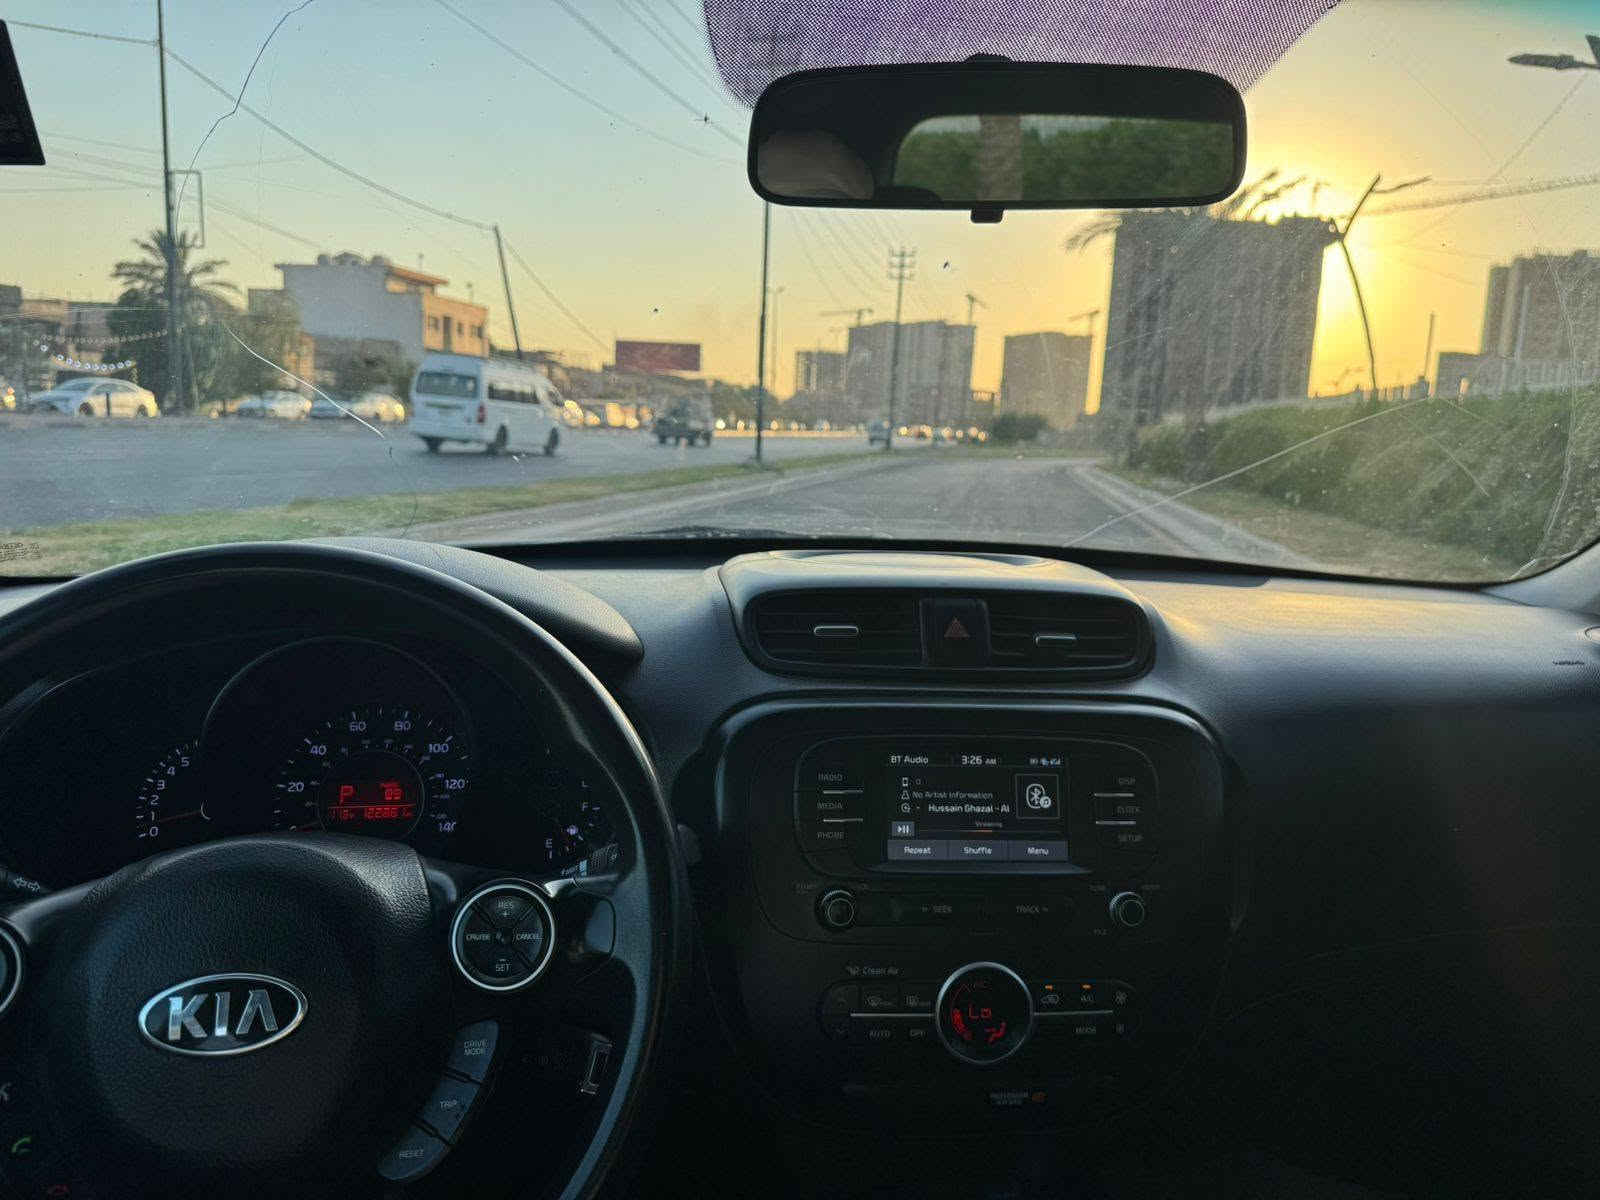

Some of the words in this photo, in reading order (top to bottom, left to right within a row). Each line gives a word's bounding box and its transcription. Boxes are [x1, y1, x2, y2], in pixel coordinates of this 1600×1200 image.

[349, 721, 368, 732] 60
[393, 720, 412, 732] 80
[309, 744, 328, 756] 40
[427, 742, 450, 753] 100
[890, 755, 901, 764] BT
[903, 755, 929, 764] Audio
[961, 755, 983, 765] 3:26
[287, 781, 305, 793] 20
[443, 778, 466, 790] 120
[338, 784, 356, 804] P
[912, 791, 923, 799] No
[949, 791, 993, 799] Information
[928, 804, 963, 813] Hussain
[964, 804, 994, 813] Ghazal
[903, 846, 932, 856] Repeat
[963, 846, 993, 856] Shuffle
[1027, 846, 1050, 857] Menu
[168, 988, 279, 1041] KIA
